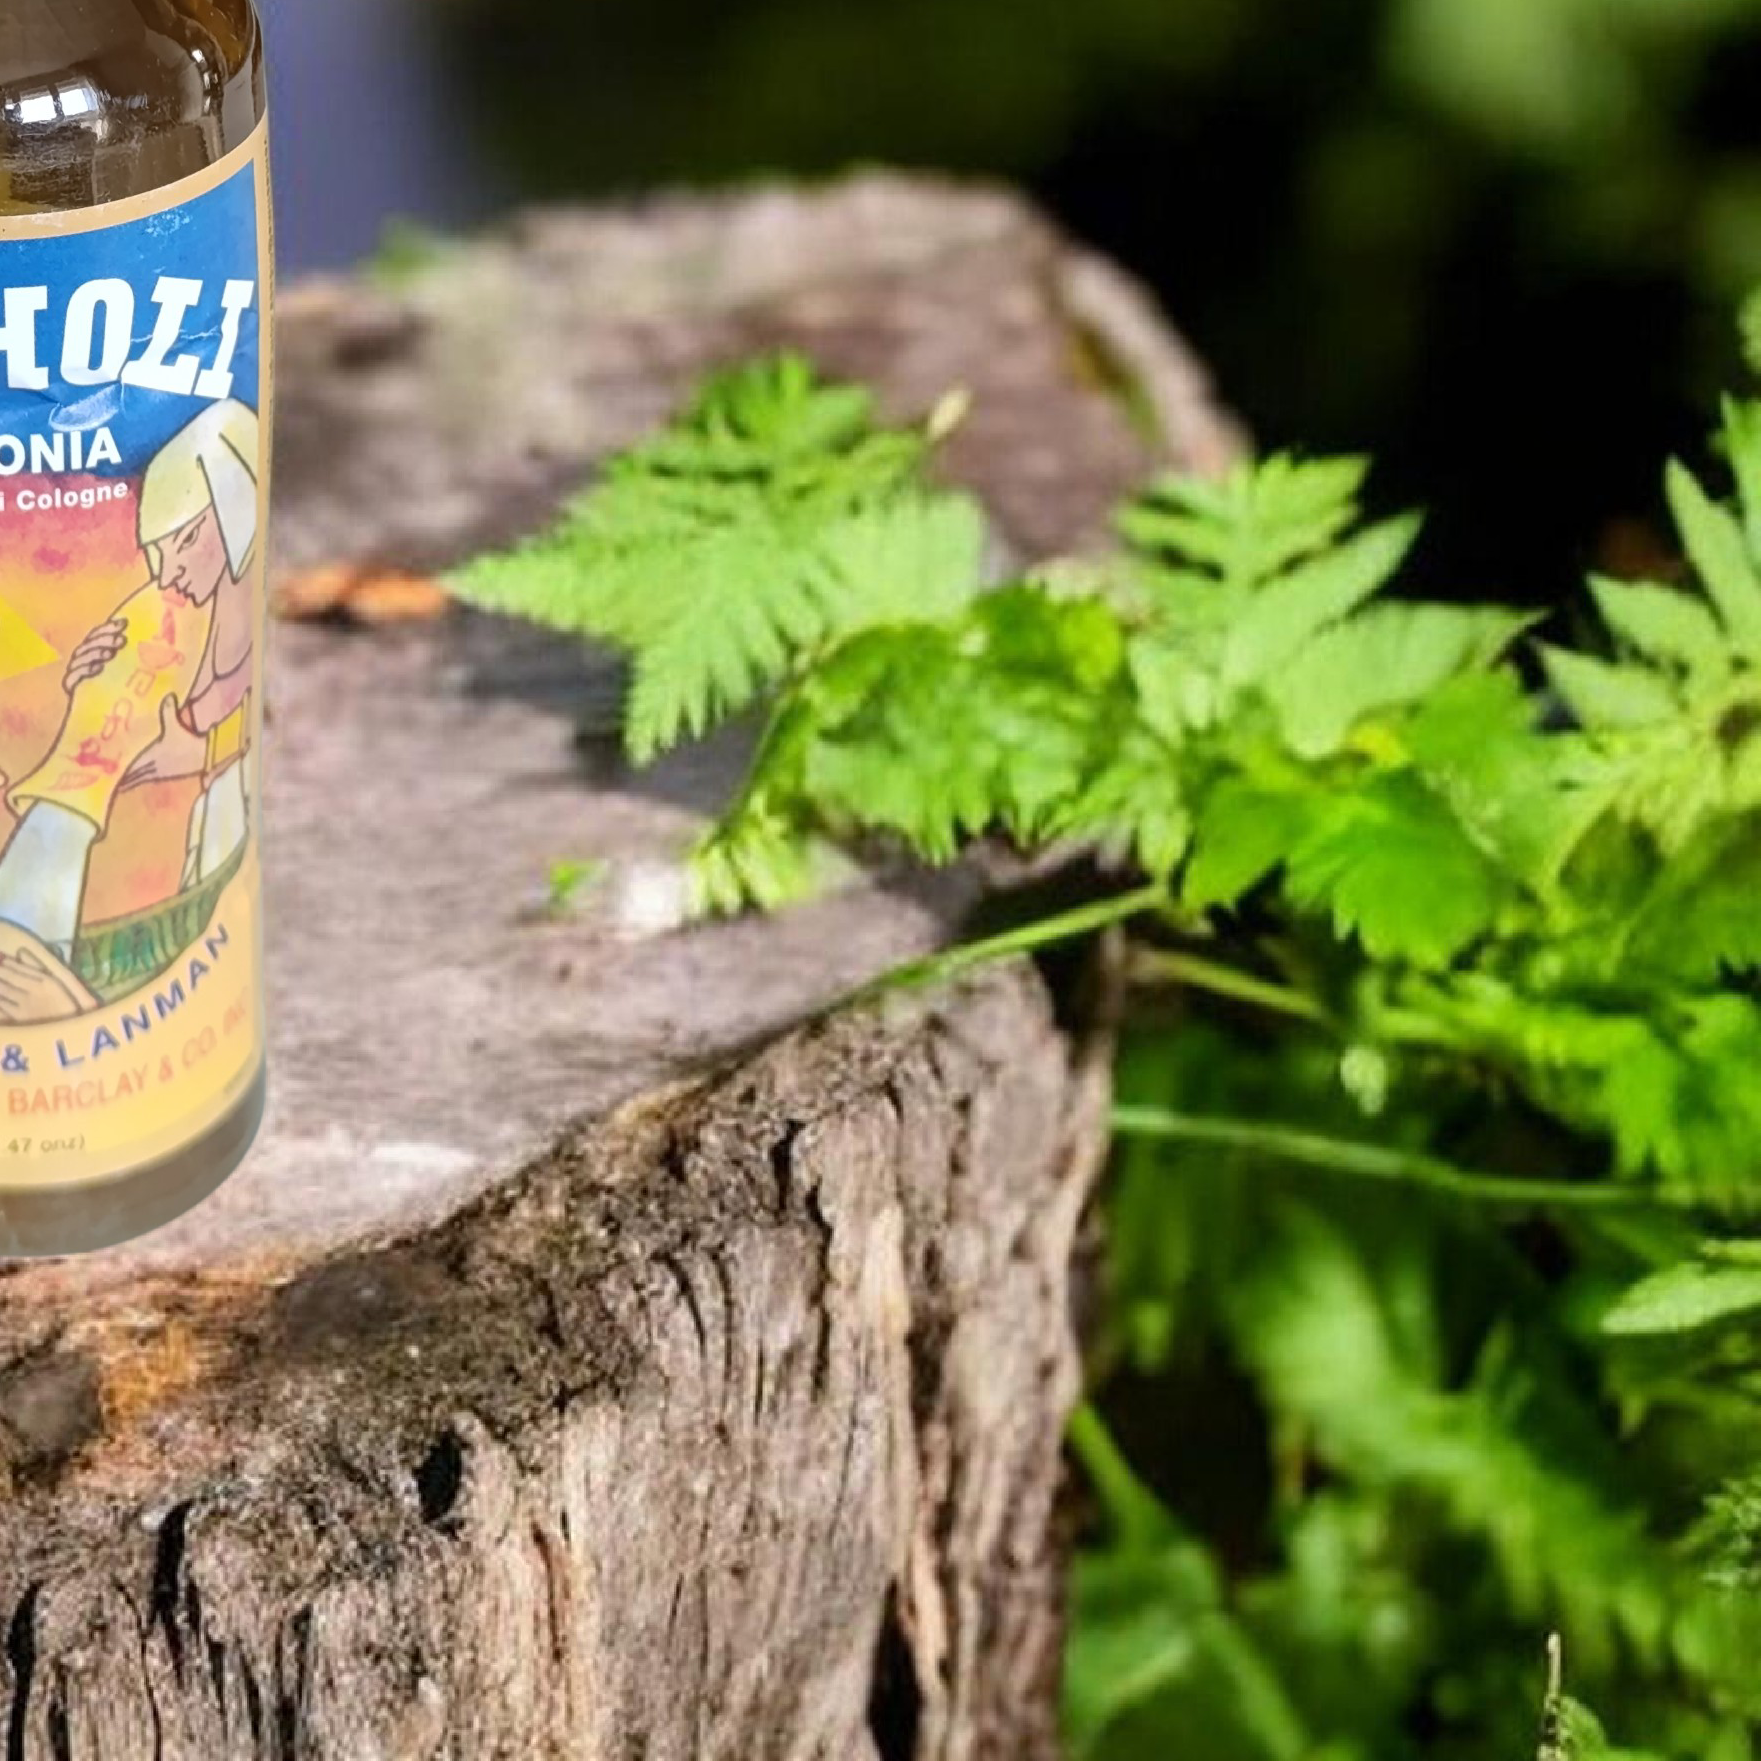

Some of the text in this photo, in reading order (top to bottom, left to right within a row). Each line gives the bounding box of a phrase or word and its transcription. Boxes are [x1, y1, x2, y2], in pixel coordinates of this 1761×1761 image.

[16, 481, 128, 512] Cologne
[0, 1043, 30, 1073] &
[55, 922, 230, 1068] LANMAN
[7, 1063, 149, 1116] BARCLAY
